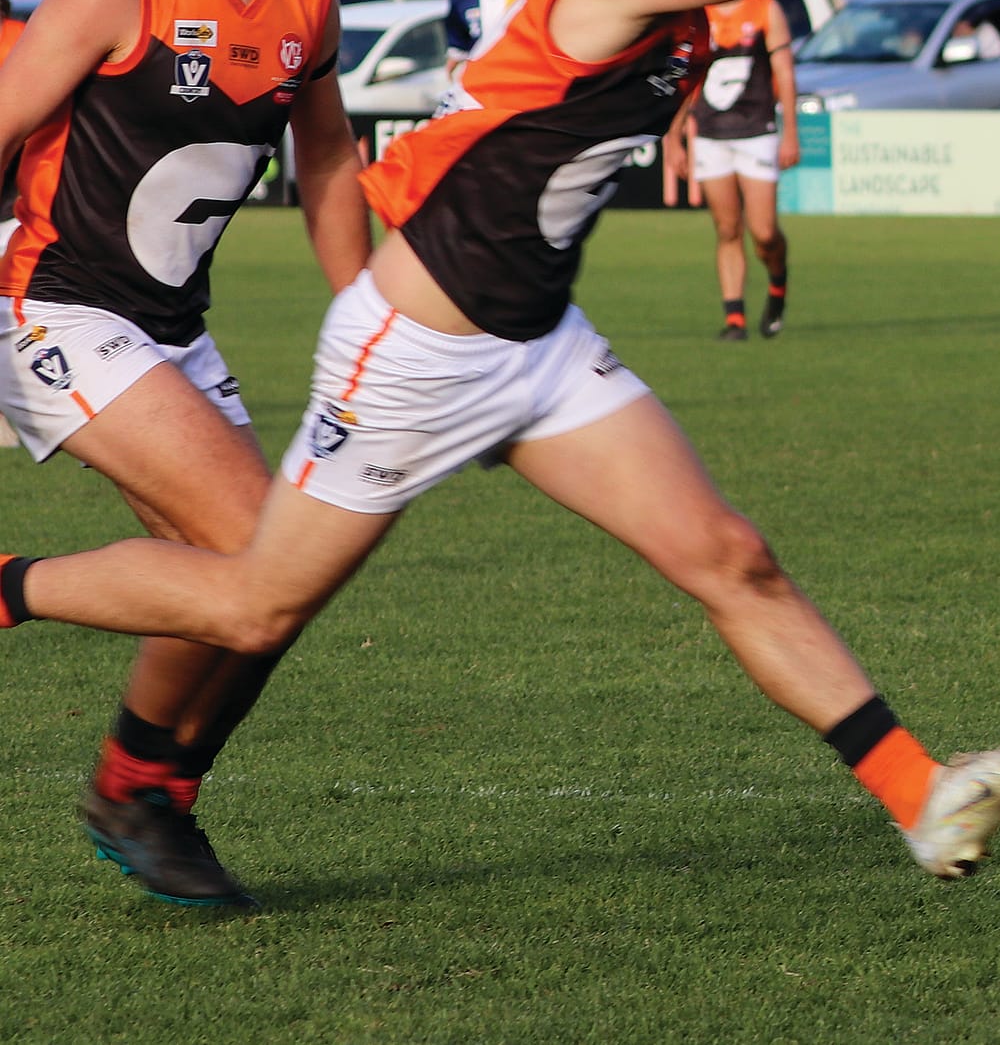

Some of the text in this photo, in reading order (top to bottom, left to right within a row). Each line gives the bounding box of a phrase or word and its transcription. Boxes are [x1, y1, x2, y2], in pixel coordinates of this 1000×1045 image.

[231, 47, 260, 61] SWD
[838, 141, 954, 167] SUSTAINABLE
[838, 173, 941, 197] LANDSCAPE
